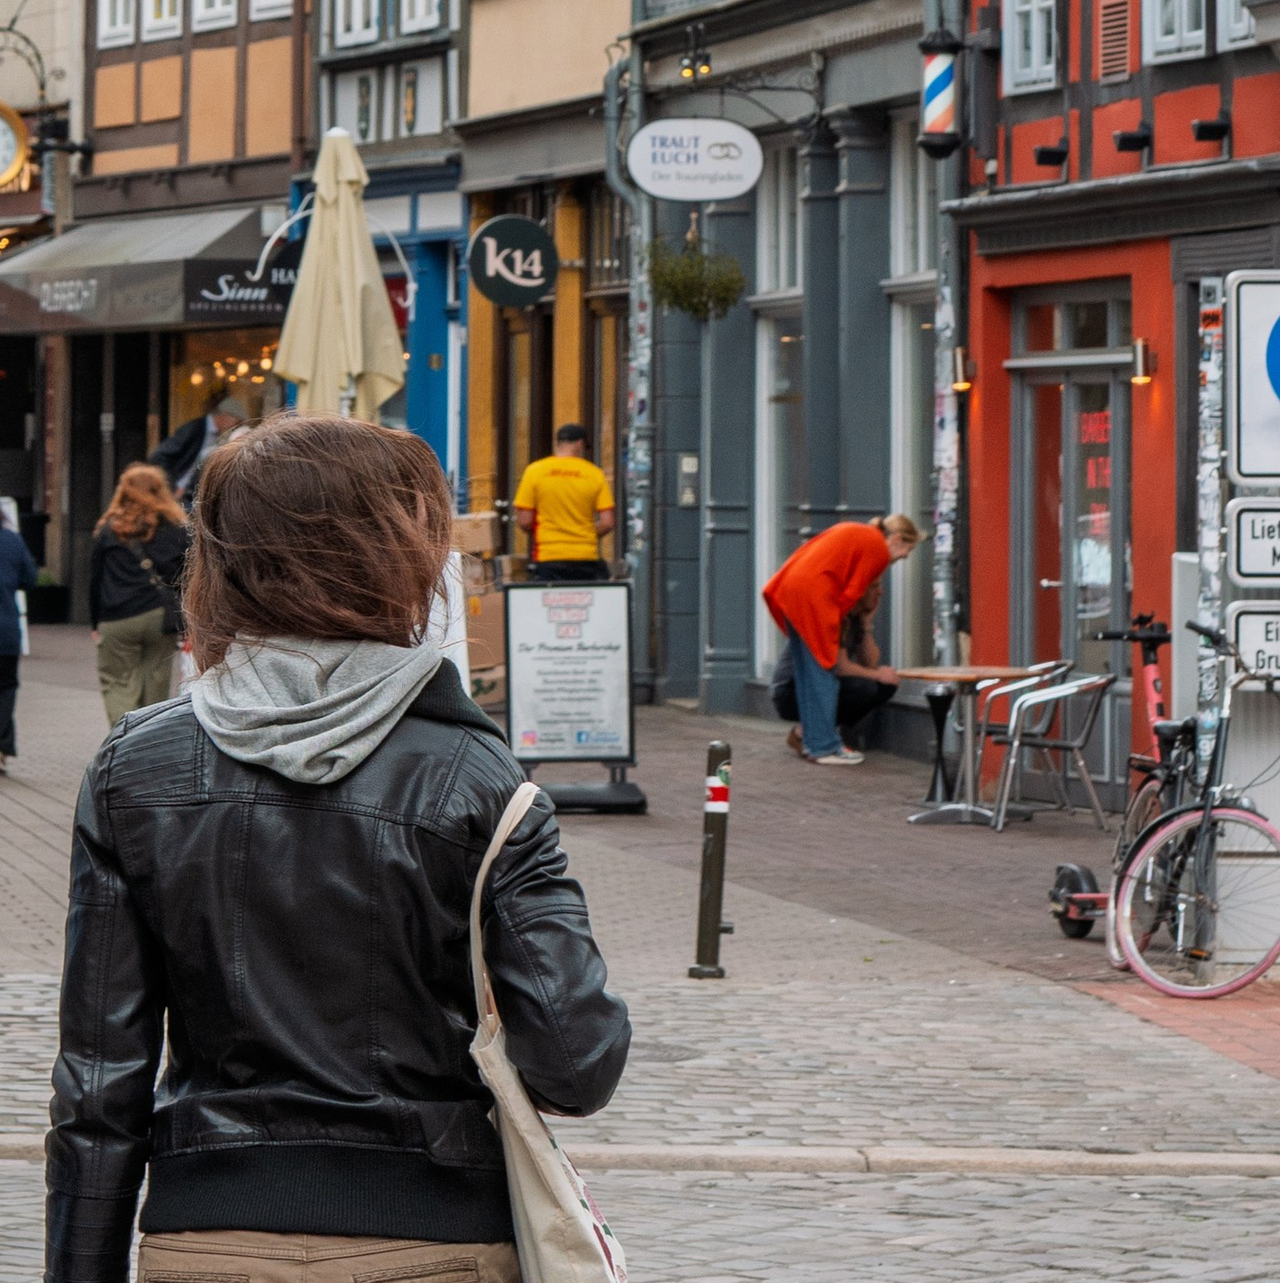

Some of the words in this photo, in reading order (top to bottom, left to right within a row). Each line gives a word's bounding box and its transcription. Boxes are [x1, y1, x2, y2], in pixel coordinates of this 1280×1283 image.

[650, 135, 701, 148] TRAUT
[651, 151, 699, 164] EUCH
[271, 267, 299, 285] HA
[200, 274, 269, 301] Sinn
